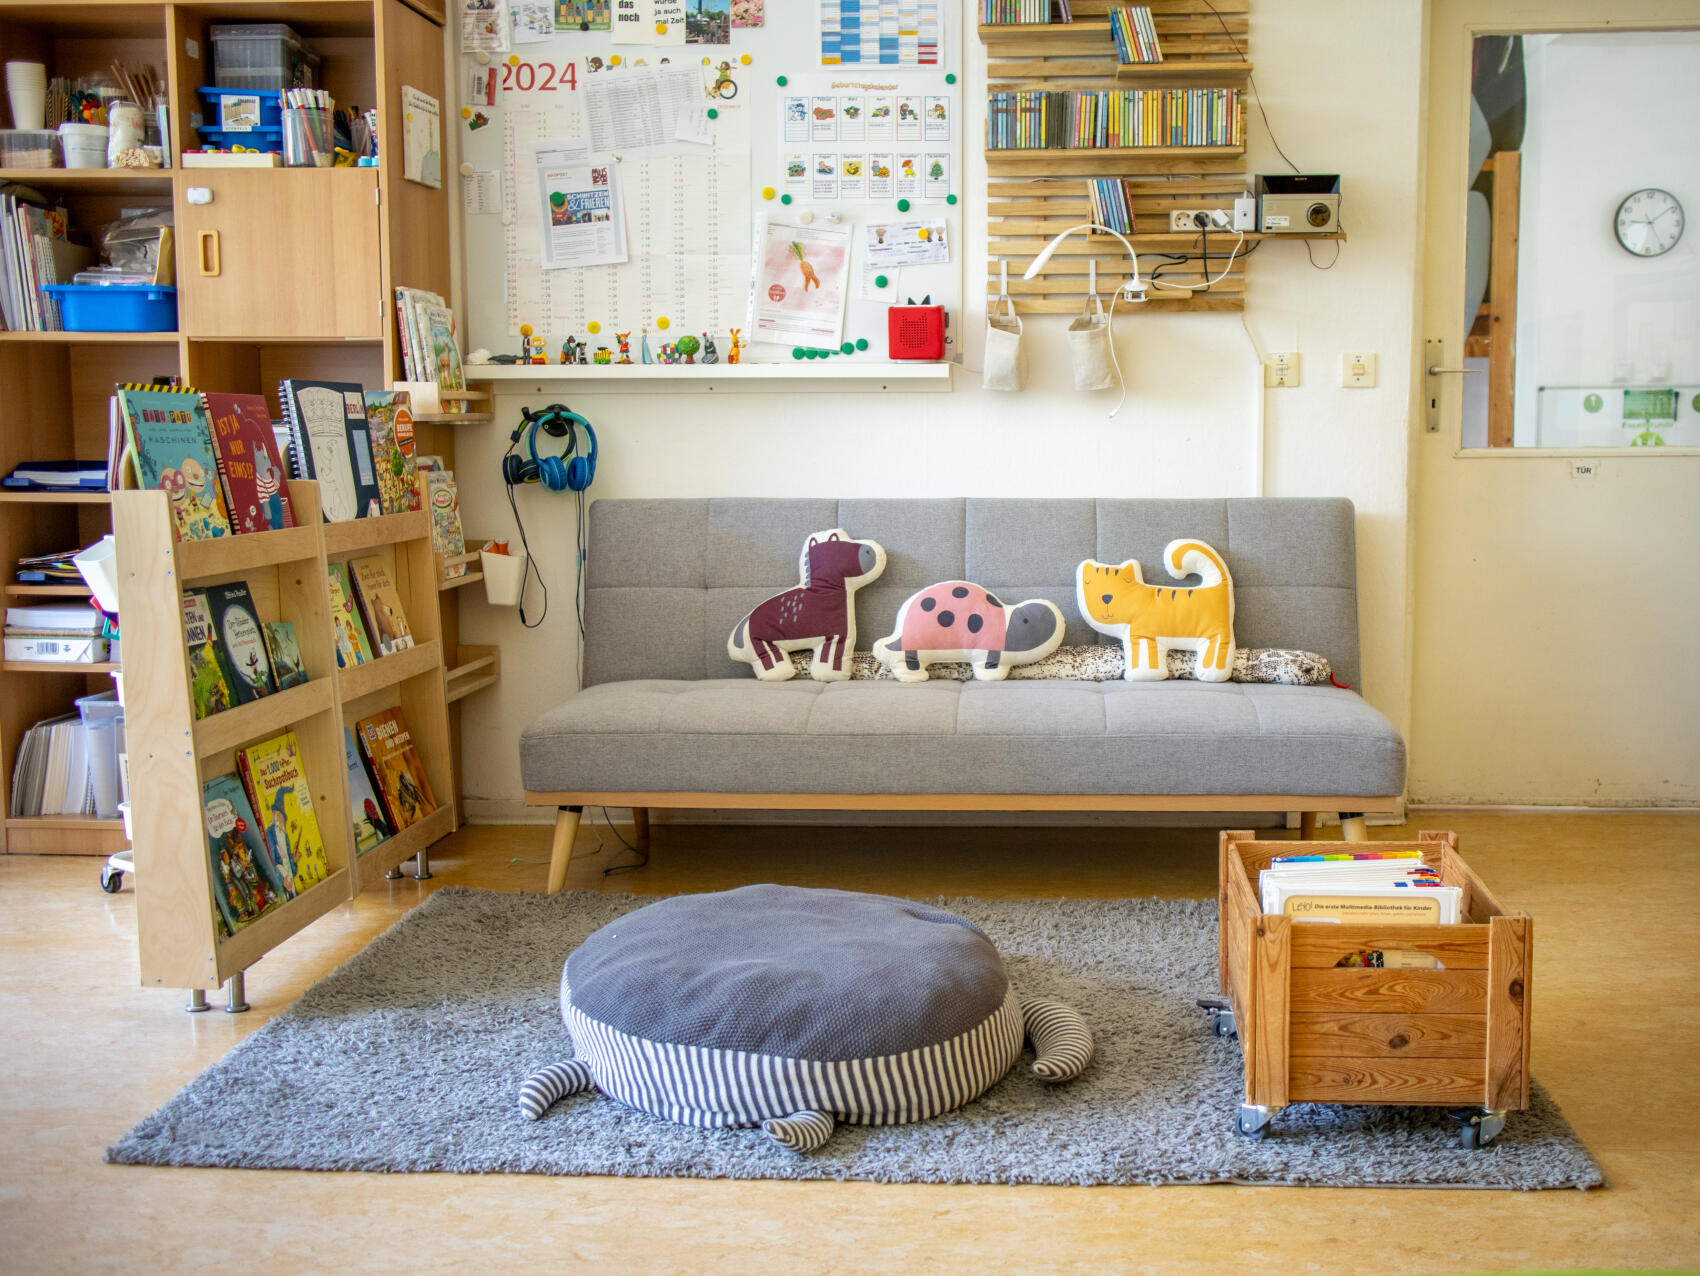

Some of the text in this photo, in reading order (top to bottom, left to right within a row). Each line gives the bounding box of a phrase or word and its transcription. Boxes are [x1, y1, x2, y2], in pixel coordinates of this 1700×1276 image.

[618, 0, 634, 8] das
[618, 13, 640, 22] noch
[654, 8, 662, 16] ja
[502, 62, 577, 91] 2024
[566, 190, 608, 200] SCHWITZEN
[568, 196, 610, 210] & FRIEREN
[346, 401, 365, 414] BERLIN
[169, 410, 192, 424] PATU
[217, 414, 240, 436] IST JA
[229, 440, 245, 455] NUR
[228, 461, 254, 479] EINS!?
[1576, 466, 1592, 474] TÜR
[376, 720, 398, 740] BIENEN
[385, 731, 410, 749] UND WESPEN
